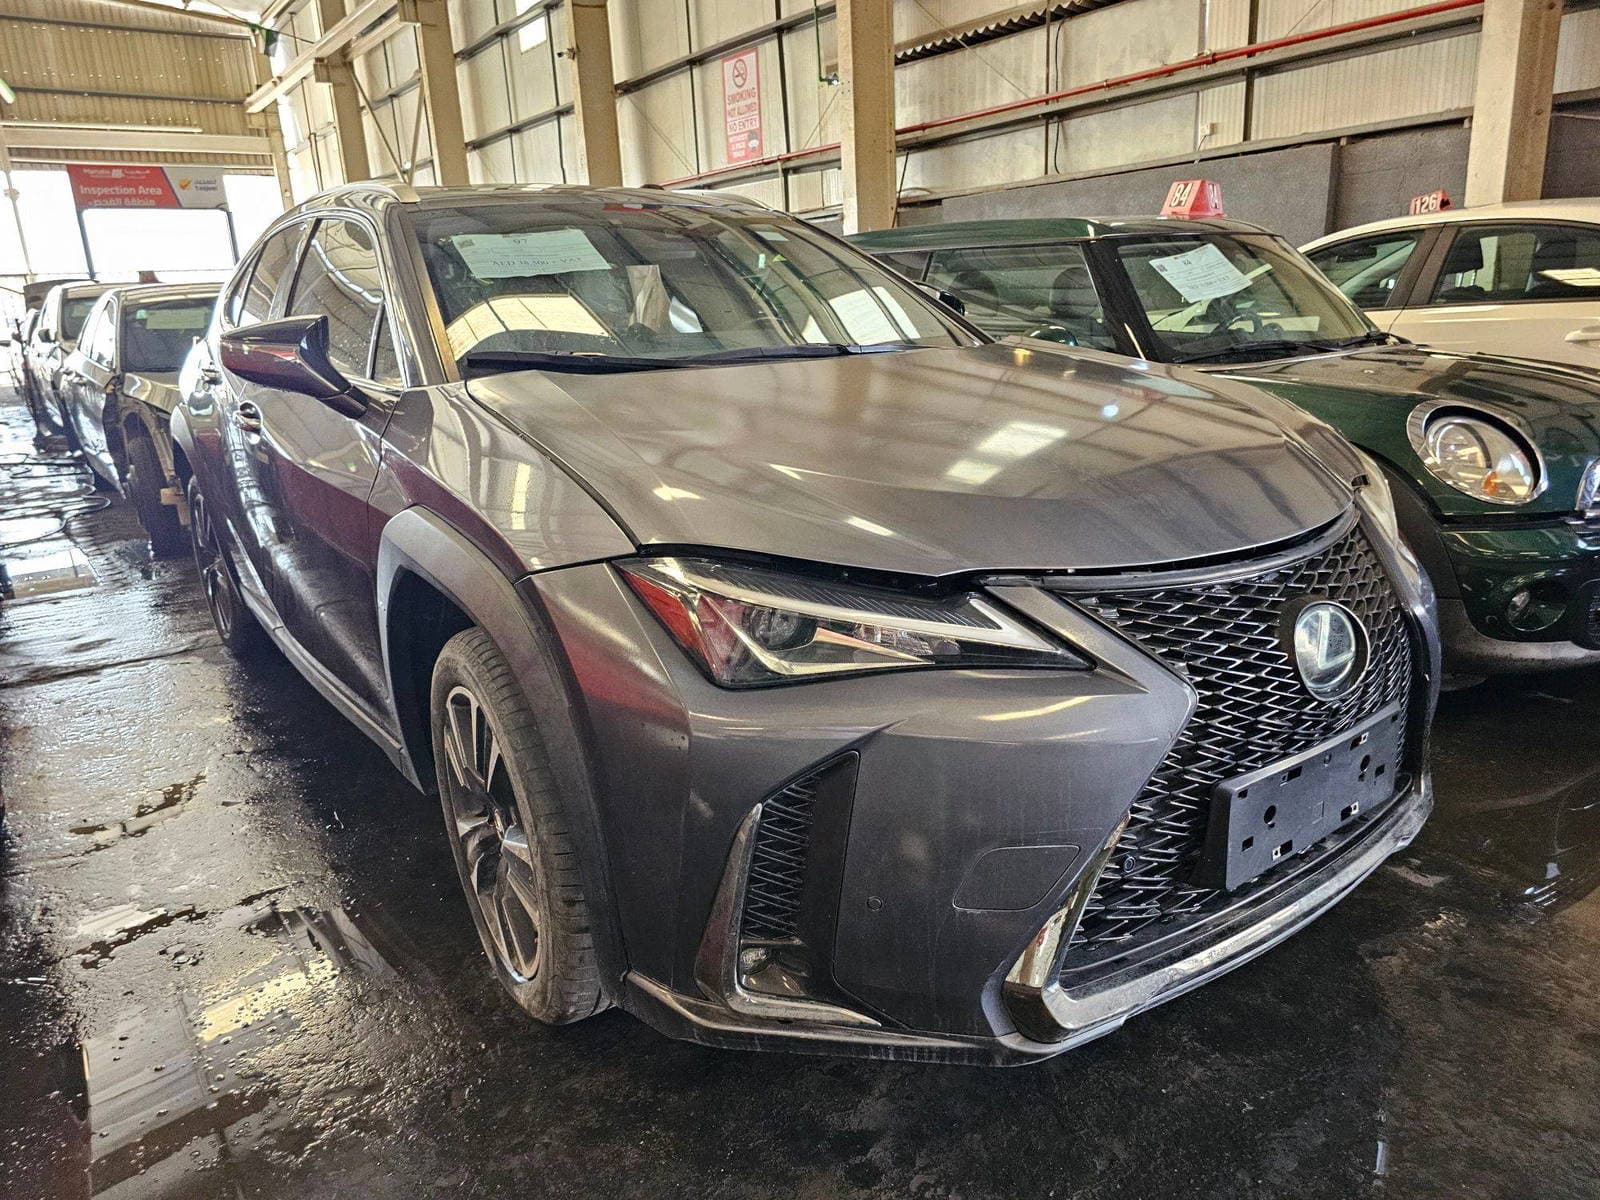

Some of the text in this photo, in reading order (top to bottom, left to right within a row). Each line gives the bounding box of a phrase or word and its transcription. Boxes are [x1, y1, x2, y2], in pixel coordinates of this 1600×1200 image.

[727, 87, 756, 105] SMOKING
[737, 102, 757, 116] ALLOWED
[728, 117, 758, 132] NO ENTRY
[79, 185, 162, 196] Inspection Area
[1169, 182, 1193, 207] 84
[1413, 193, 1438, 215] 126
